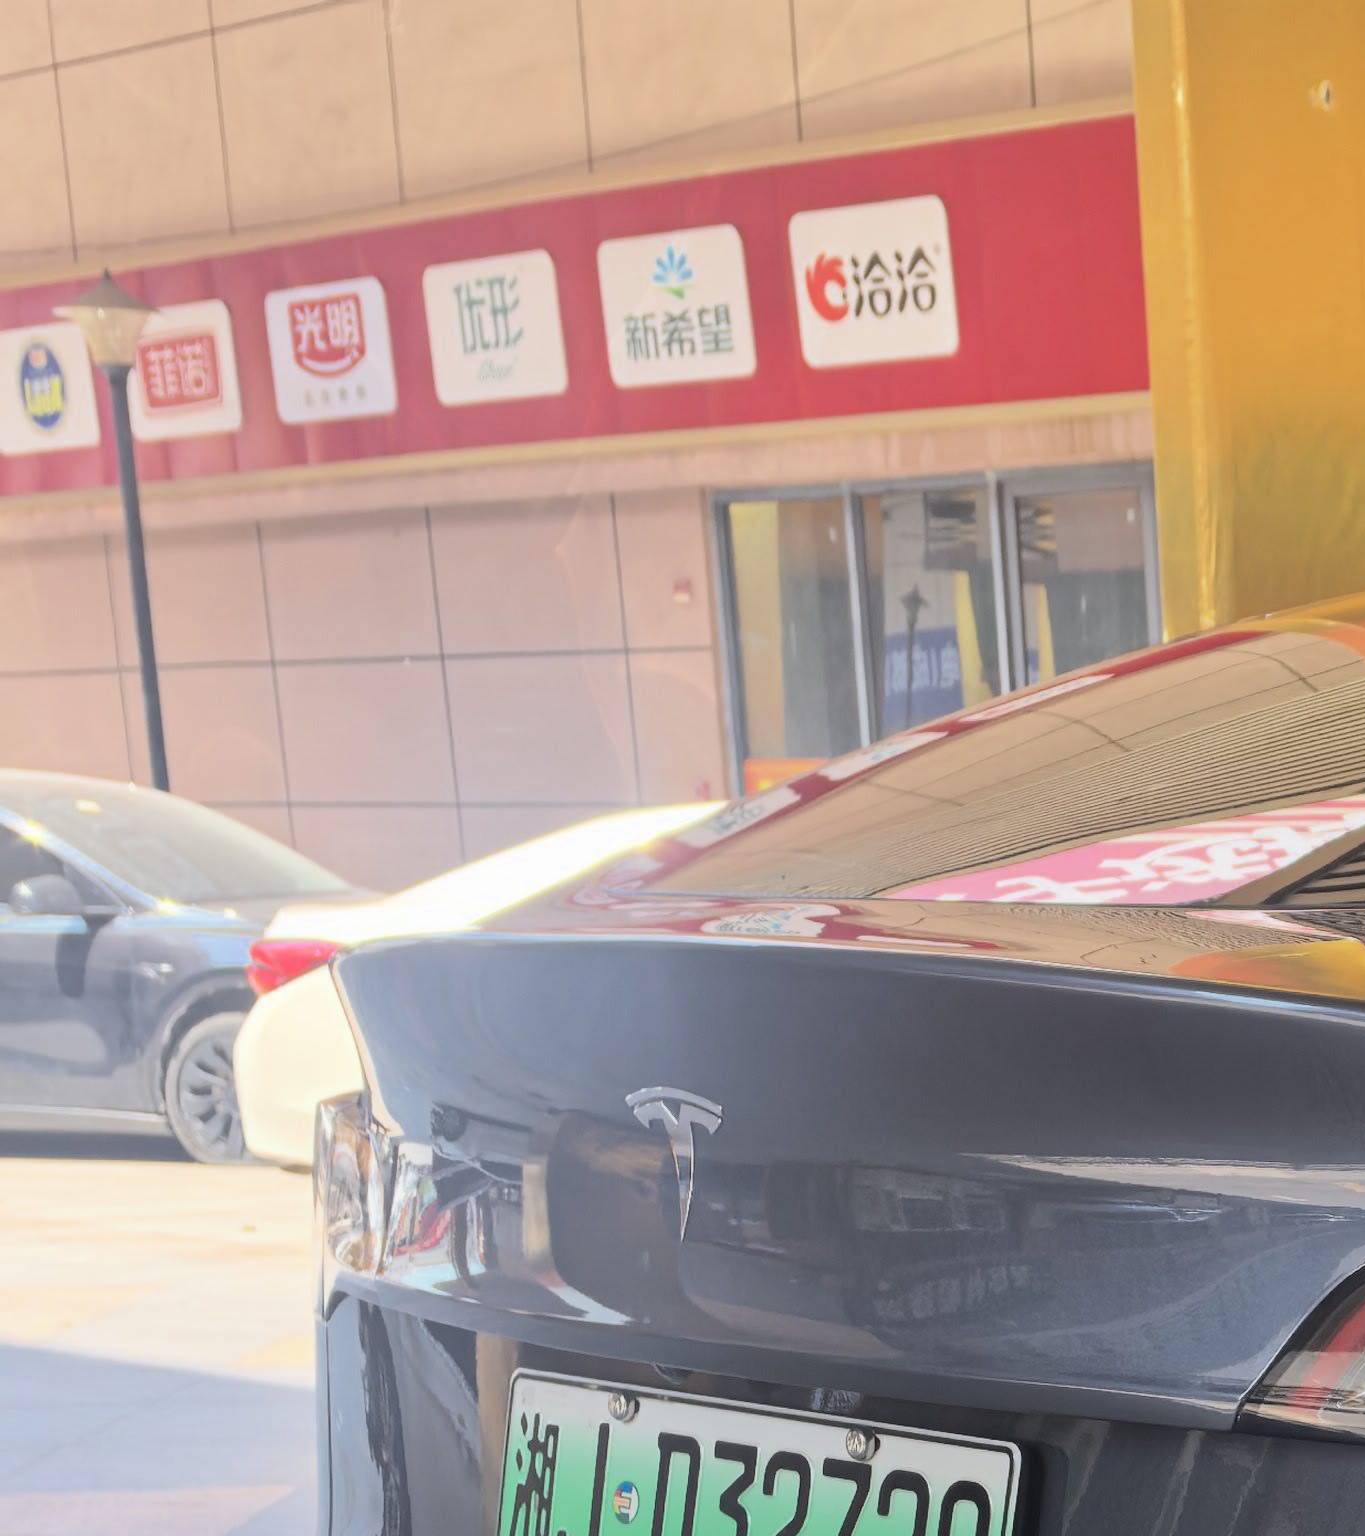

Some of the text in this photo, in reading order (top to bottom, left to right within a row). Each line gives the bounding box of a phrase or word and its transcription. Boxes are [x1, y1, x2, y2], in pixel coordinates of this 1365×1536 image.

[850, 246, 938, 318] 洽洽
[293, 298, 361, 352] 光明
[624, 303, 735, 361] 新希望
